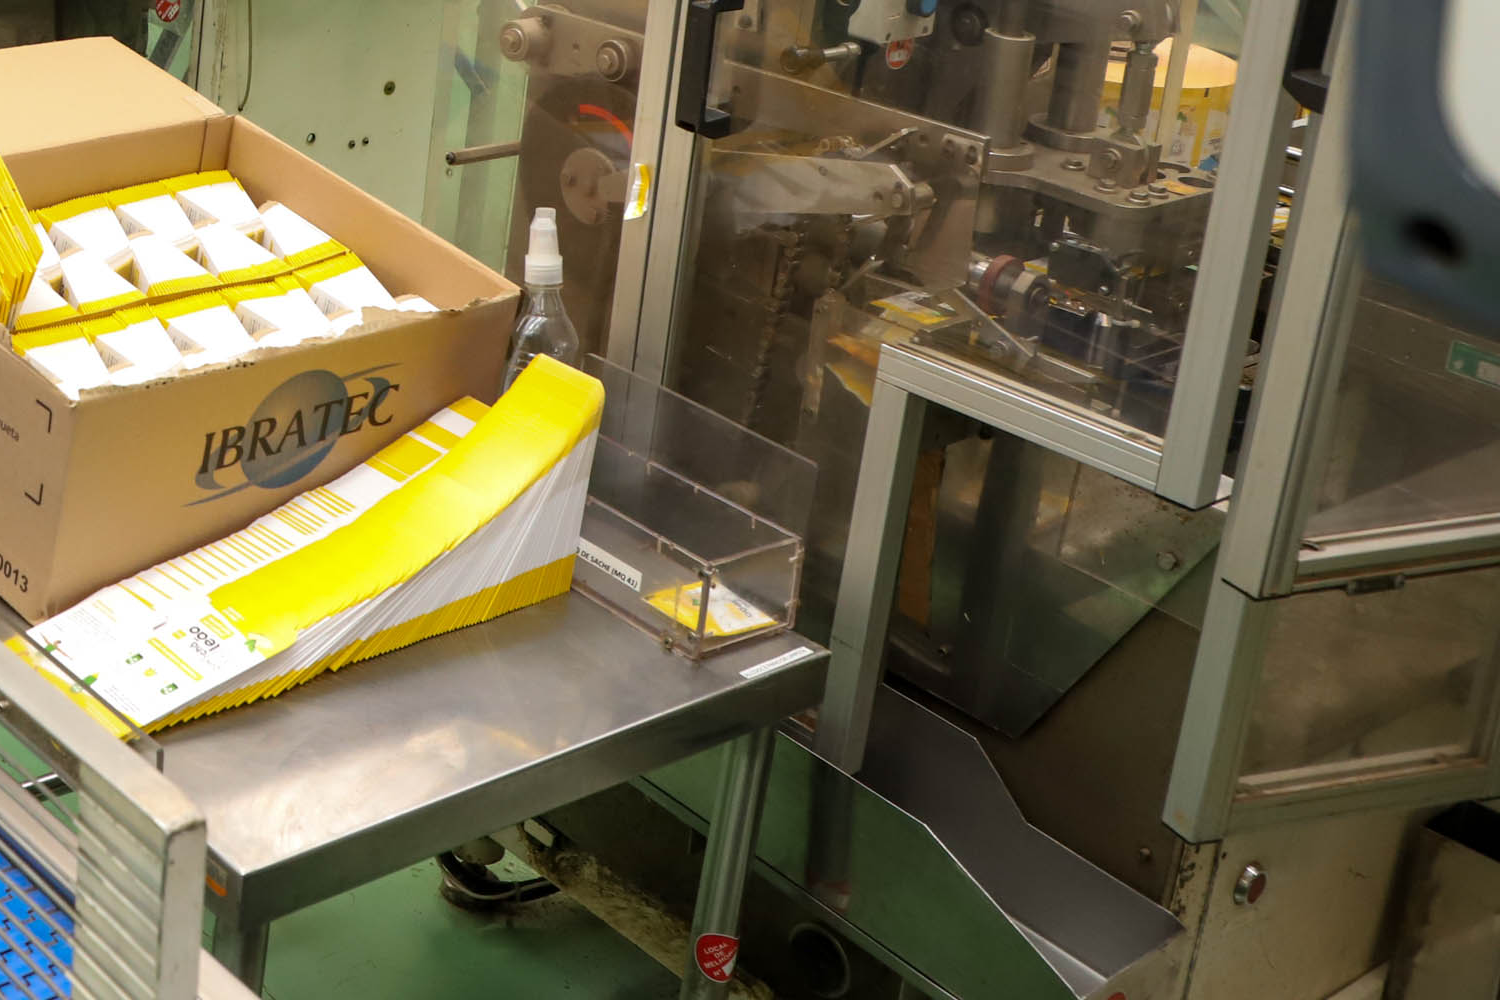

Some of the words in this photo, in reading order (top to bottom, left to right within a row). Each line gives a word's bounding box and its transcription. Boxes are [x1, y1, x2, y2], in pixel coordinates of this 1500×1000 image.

[198, 384, 400, 474] IBRATEC
[581, 550, 590, 560] DE
[590, 556, 611, 572] SACHE
